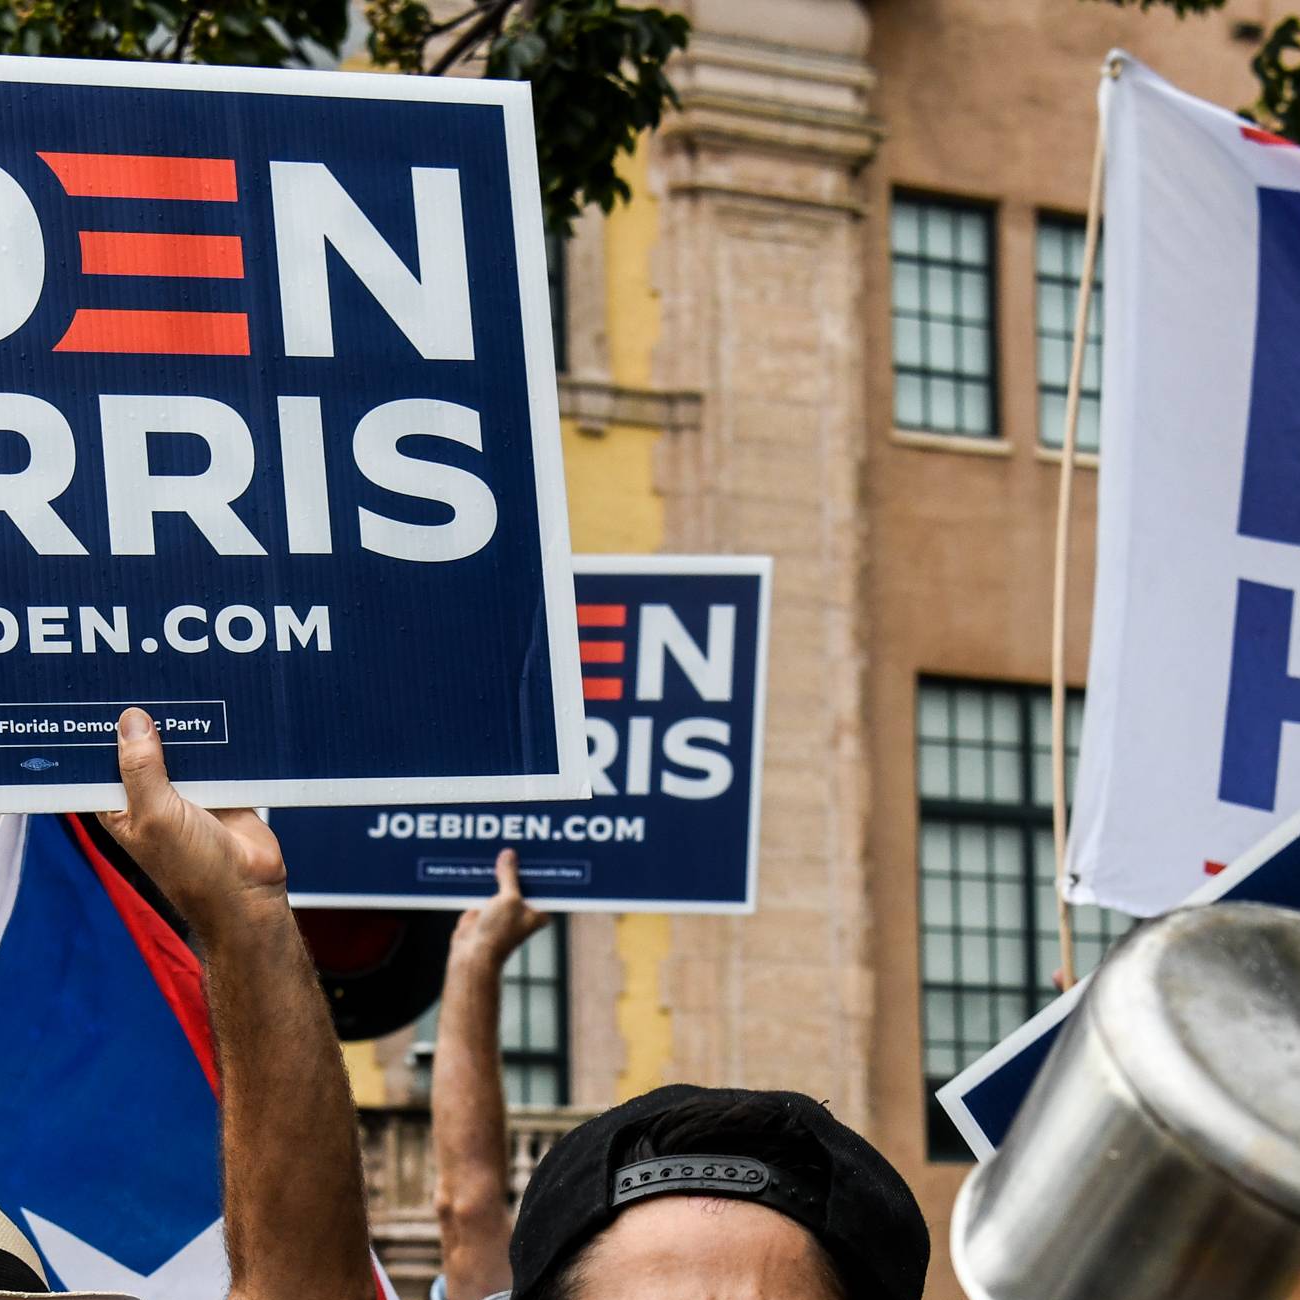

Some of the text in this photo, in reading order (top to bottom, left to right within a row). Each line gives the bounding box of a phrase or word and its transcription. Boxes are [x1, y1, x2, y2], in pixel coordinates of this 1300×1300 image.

[63, 717, 162, 732] Democ
[165, 716, 212, 733] Party
[367, 812, 646, 844] JOEBIDEN.COM
